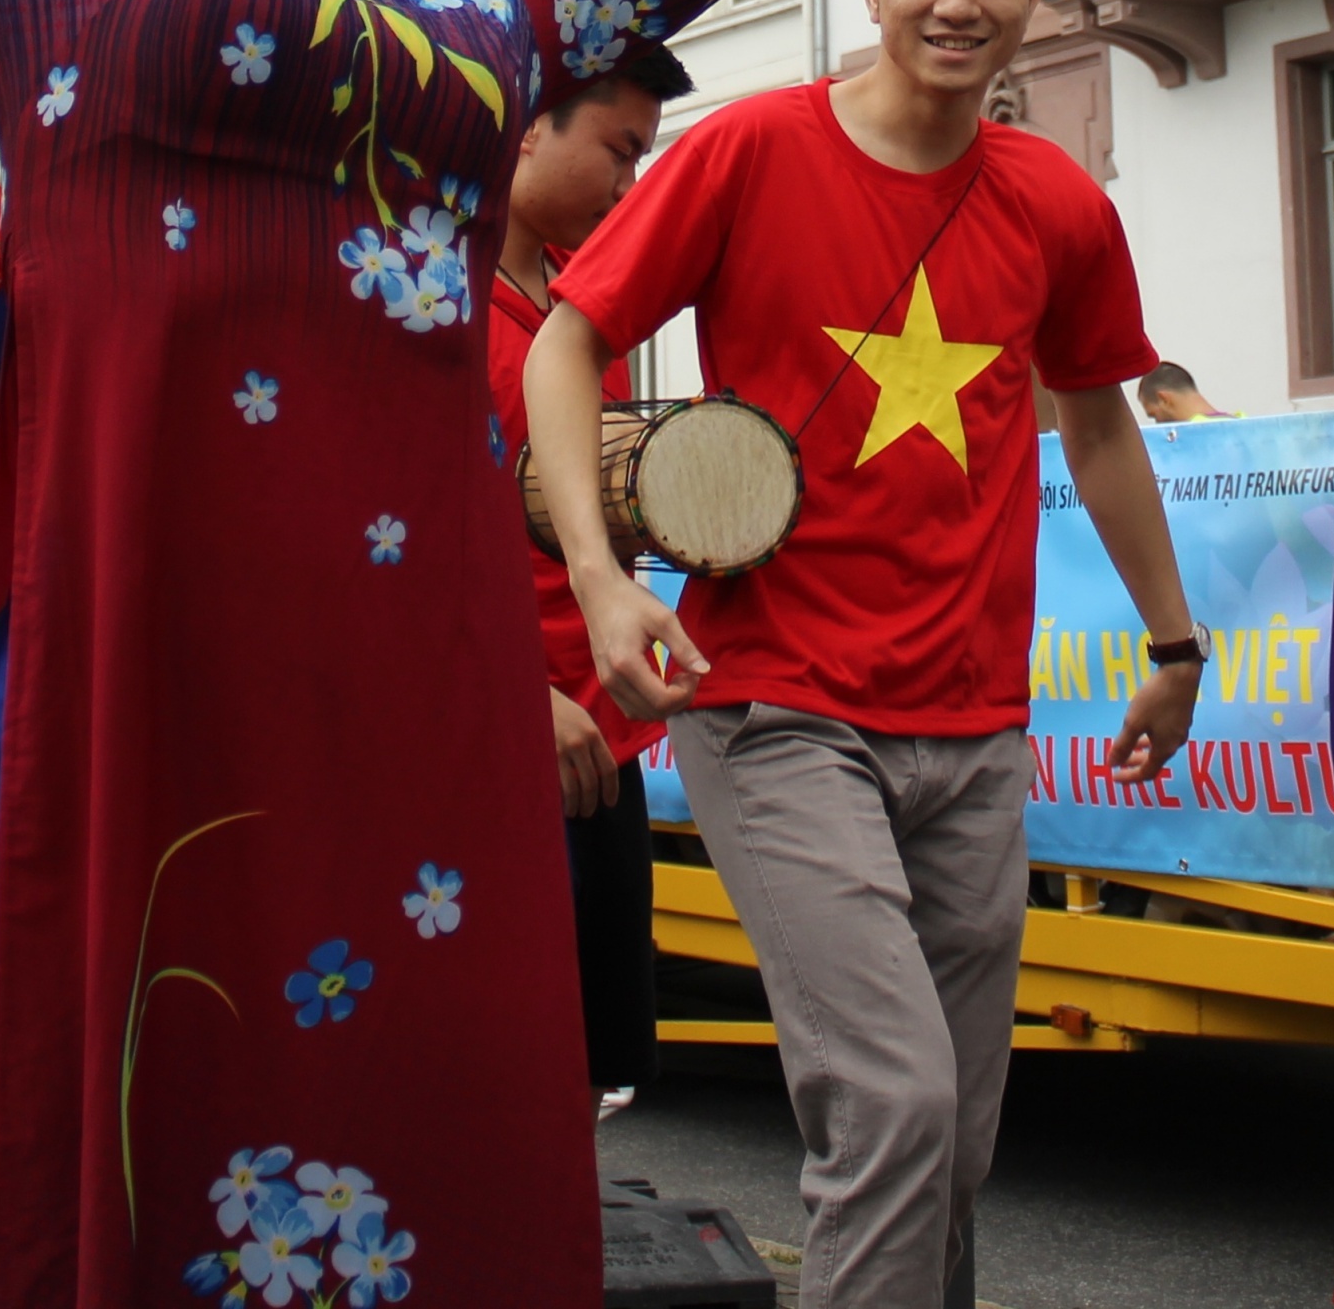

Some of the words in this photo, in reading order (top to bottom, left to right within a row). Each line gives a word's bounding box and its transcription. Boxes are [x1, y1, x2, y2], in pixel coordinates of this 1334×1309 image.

[1170, 475, 1208, 502] NAM
[1215, 472, 1241, 507] TẠI
[1031, 616, 1091, 701] ĂN
[1215, 613, 1321, 726] VIỆT
